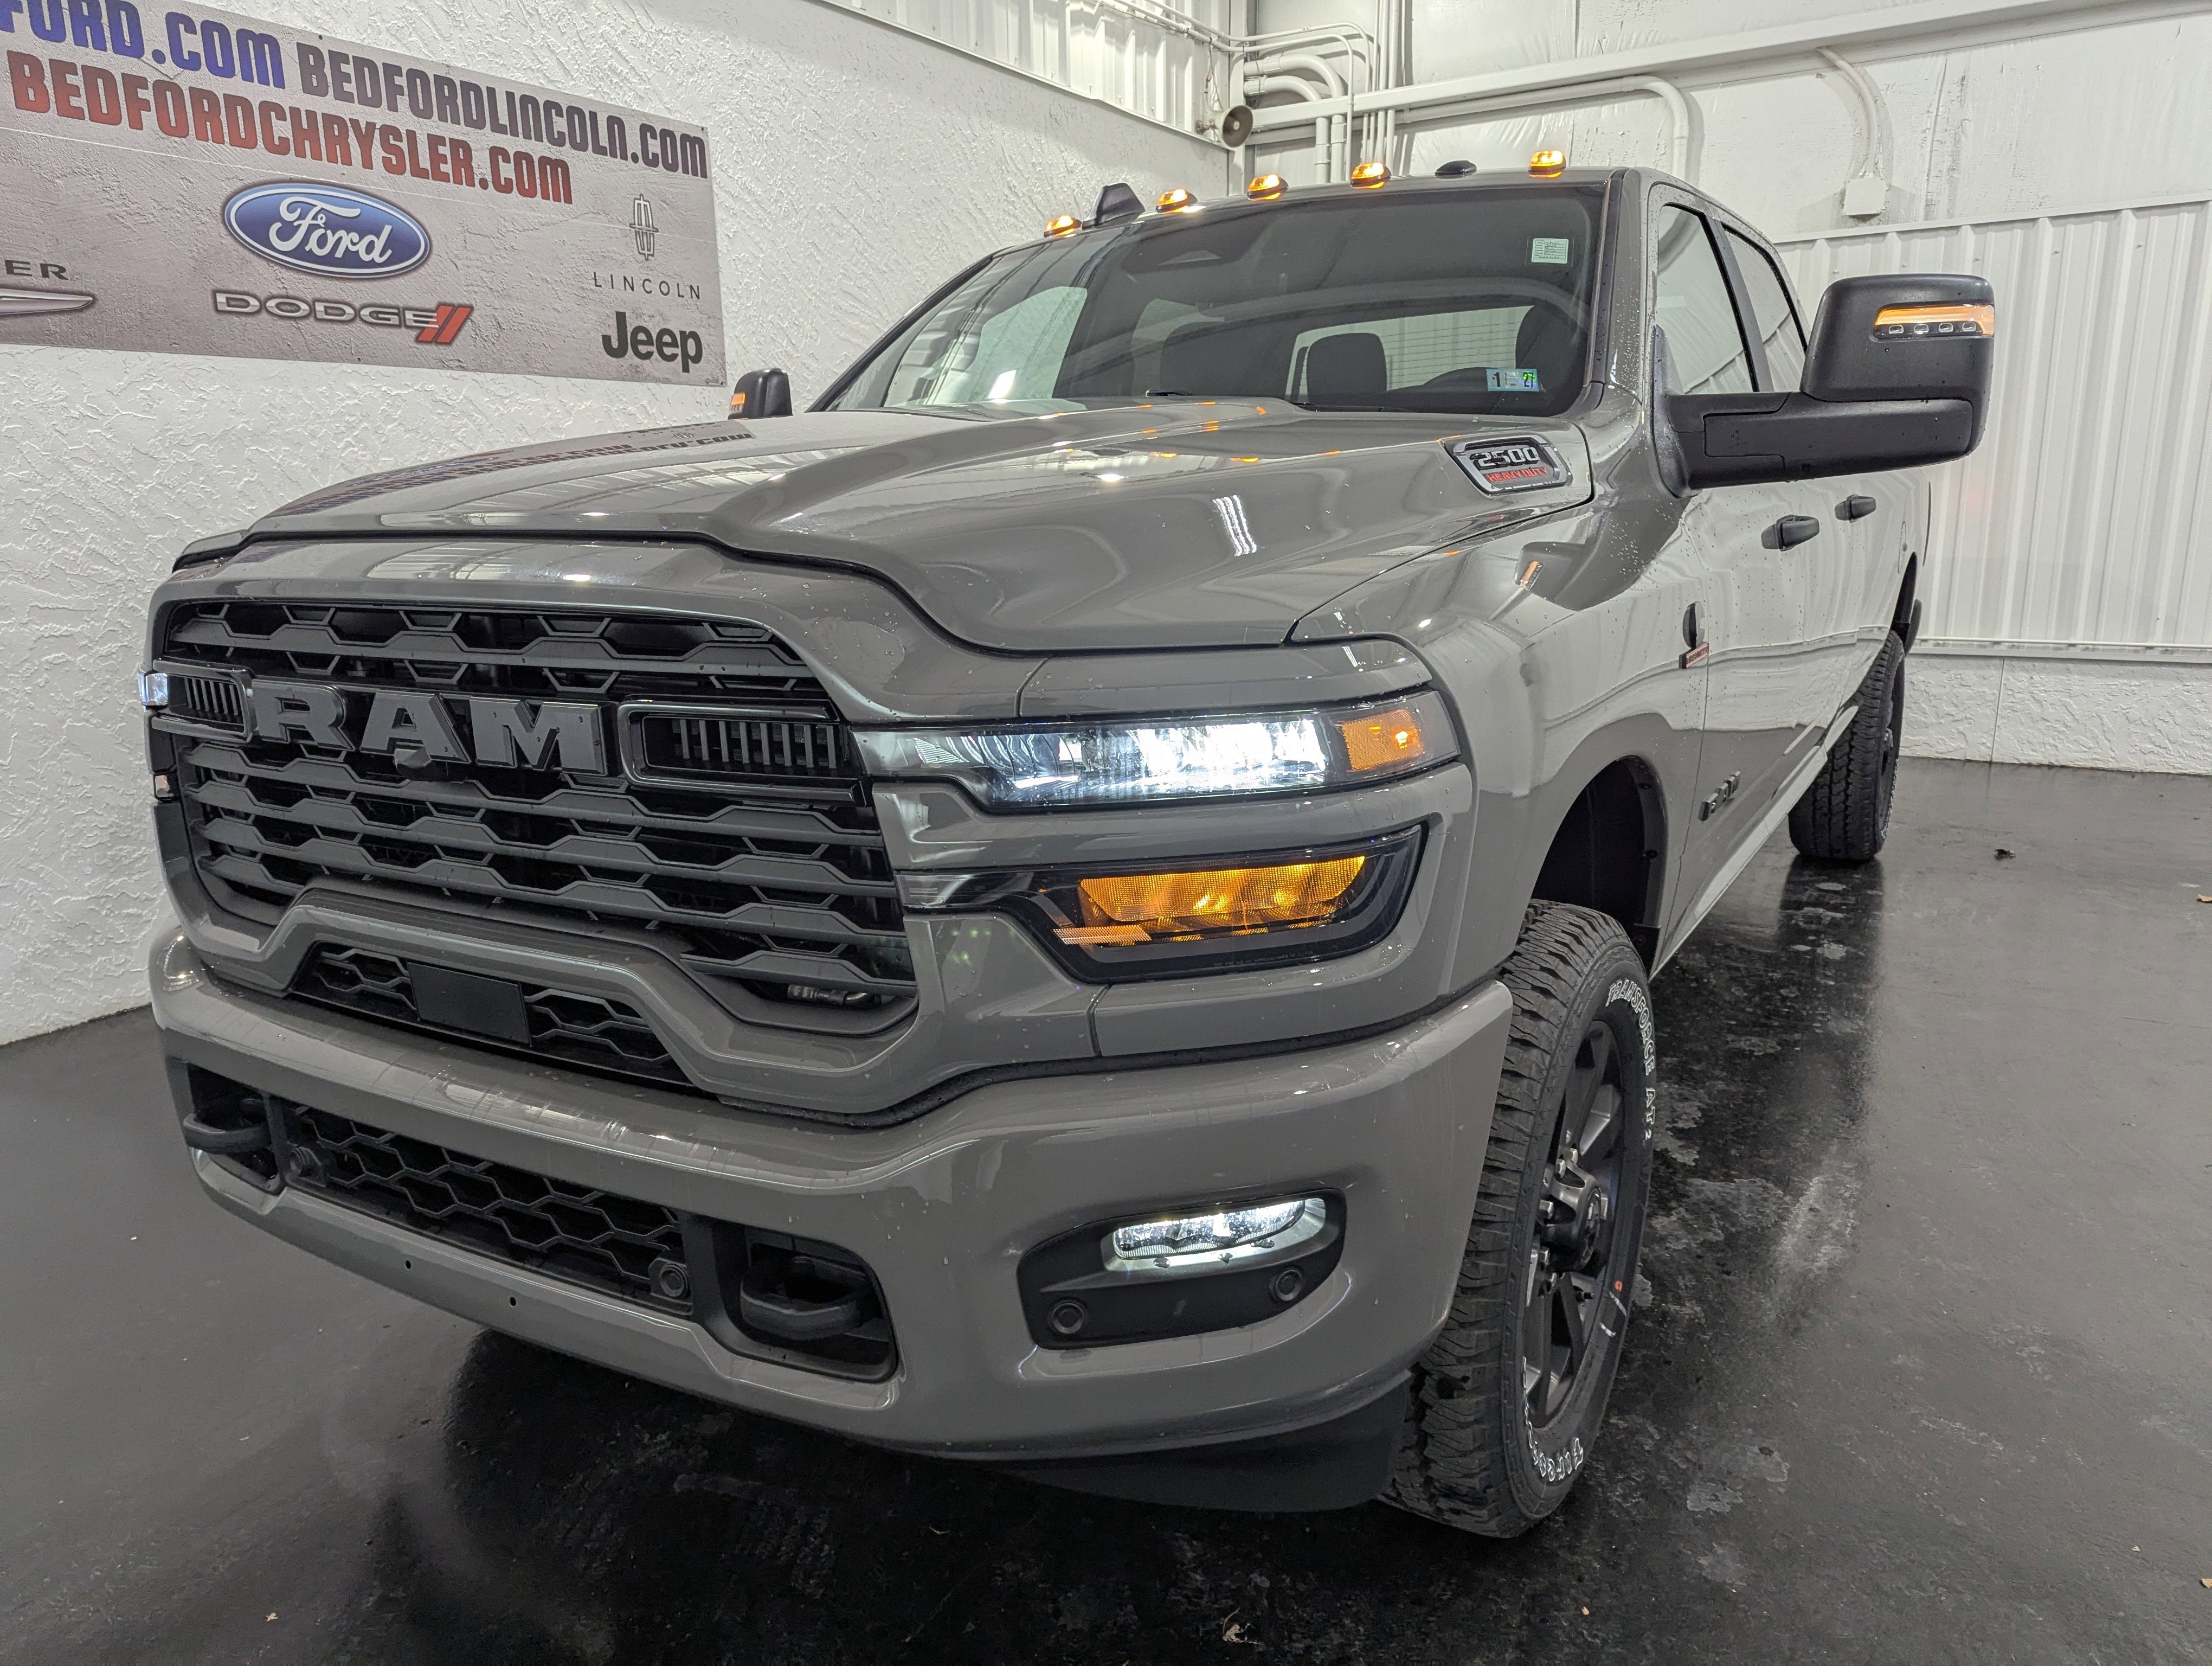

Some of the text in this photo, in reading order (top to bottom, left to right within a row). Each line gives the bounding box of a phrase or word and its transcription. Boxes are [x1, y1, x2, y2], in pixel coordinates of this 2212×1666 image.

[8, 50, 573, 204] BEDFORDCHRYSLER.COM
[297, 43, 708, 179] BEDFORDLINCOLN.COM
[269, 196, 393, 263] Ford
[216, 293, 438, 328] DODGE
[594, 272, 700, 299] LINCOLN
[602, 311, 703, 373] Jeep
[1470, 447, 1540, 470] 2500
[1485, 467, 1548, 482] HEAVY DUTY
[251, 678, 608, 777] RAM
[1605, 979, 1655, 1076] TRANSFORCE
